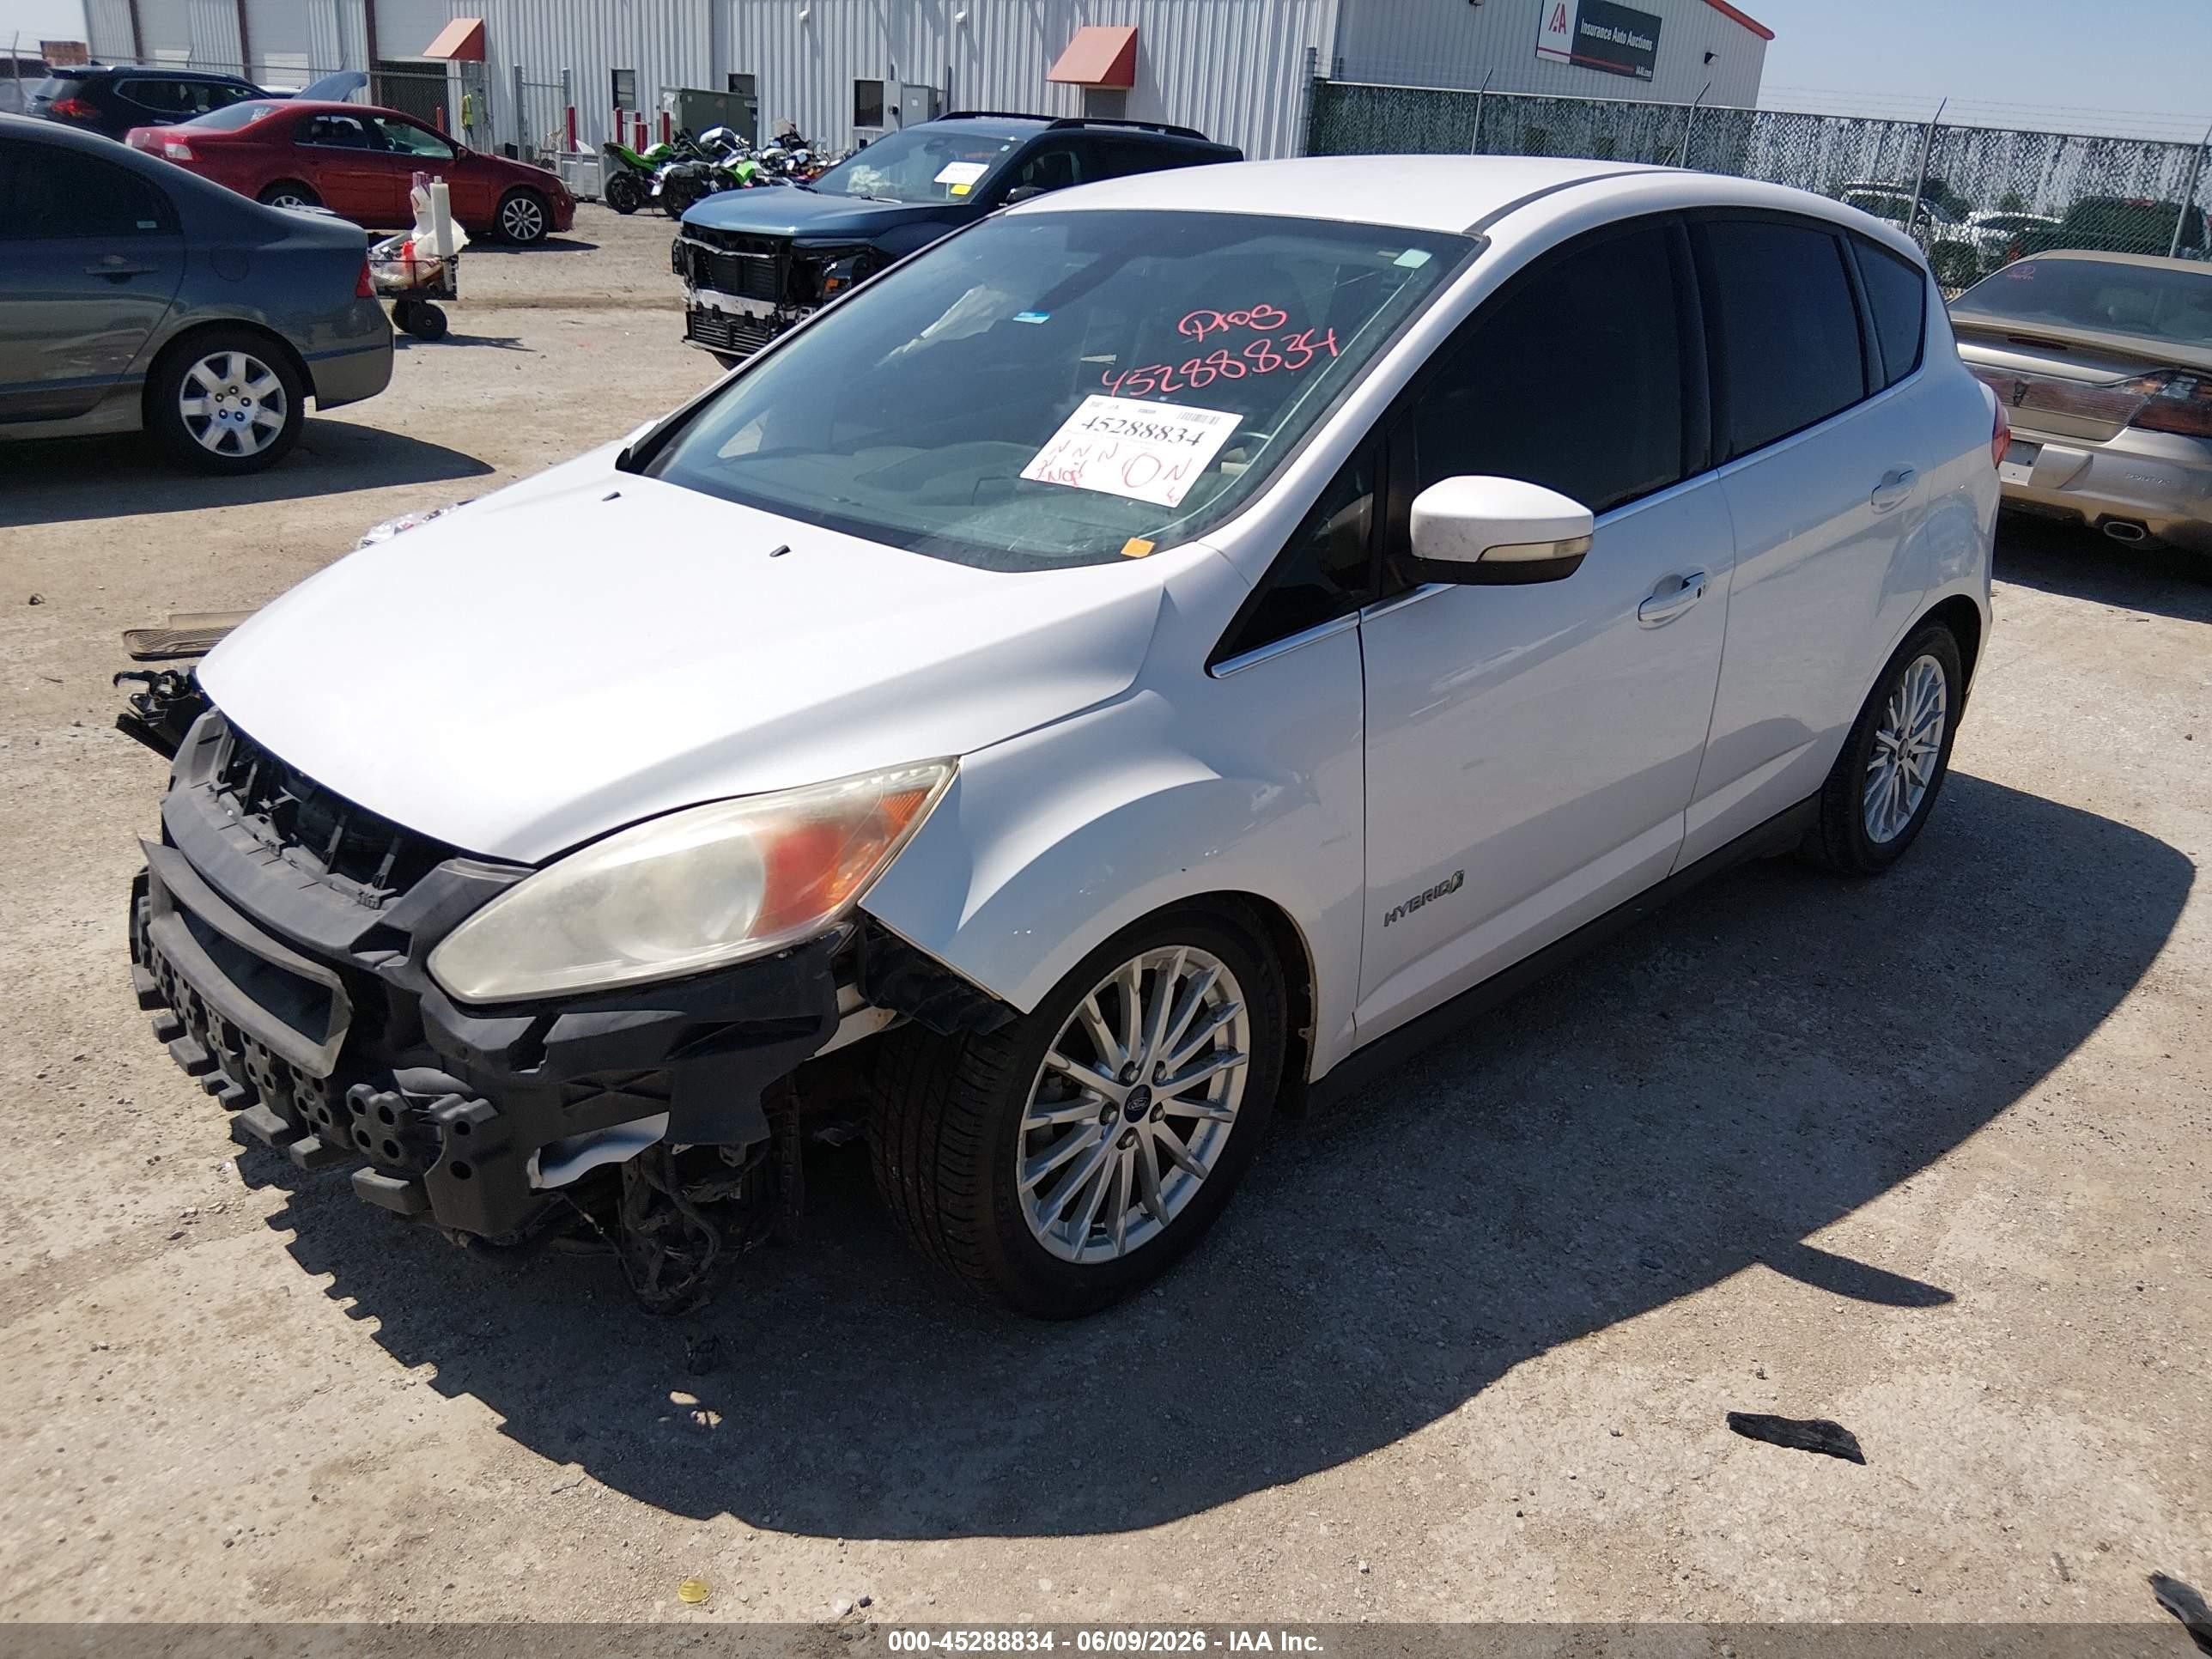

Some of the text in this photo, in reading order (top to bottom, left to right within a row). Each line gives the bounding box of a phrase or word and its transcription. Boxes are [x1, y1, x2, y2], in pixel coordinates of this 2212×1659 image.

[1580, 17, 1653, 52] Insurance Auto Auctions
[1102, 328, 1338, 398] 45288834
[1081, 416, 1205, 446] 45288834
[1383, 879, 1450, 927] HYBRID
